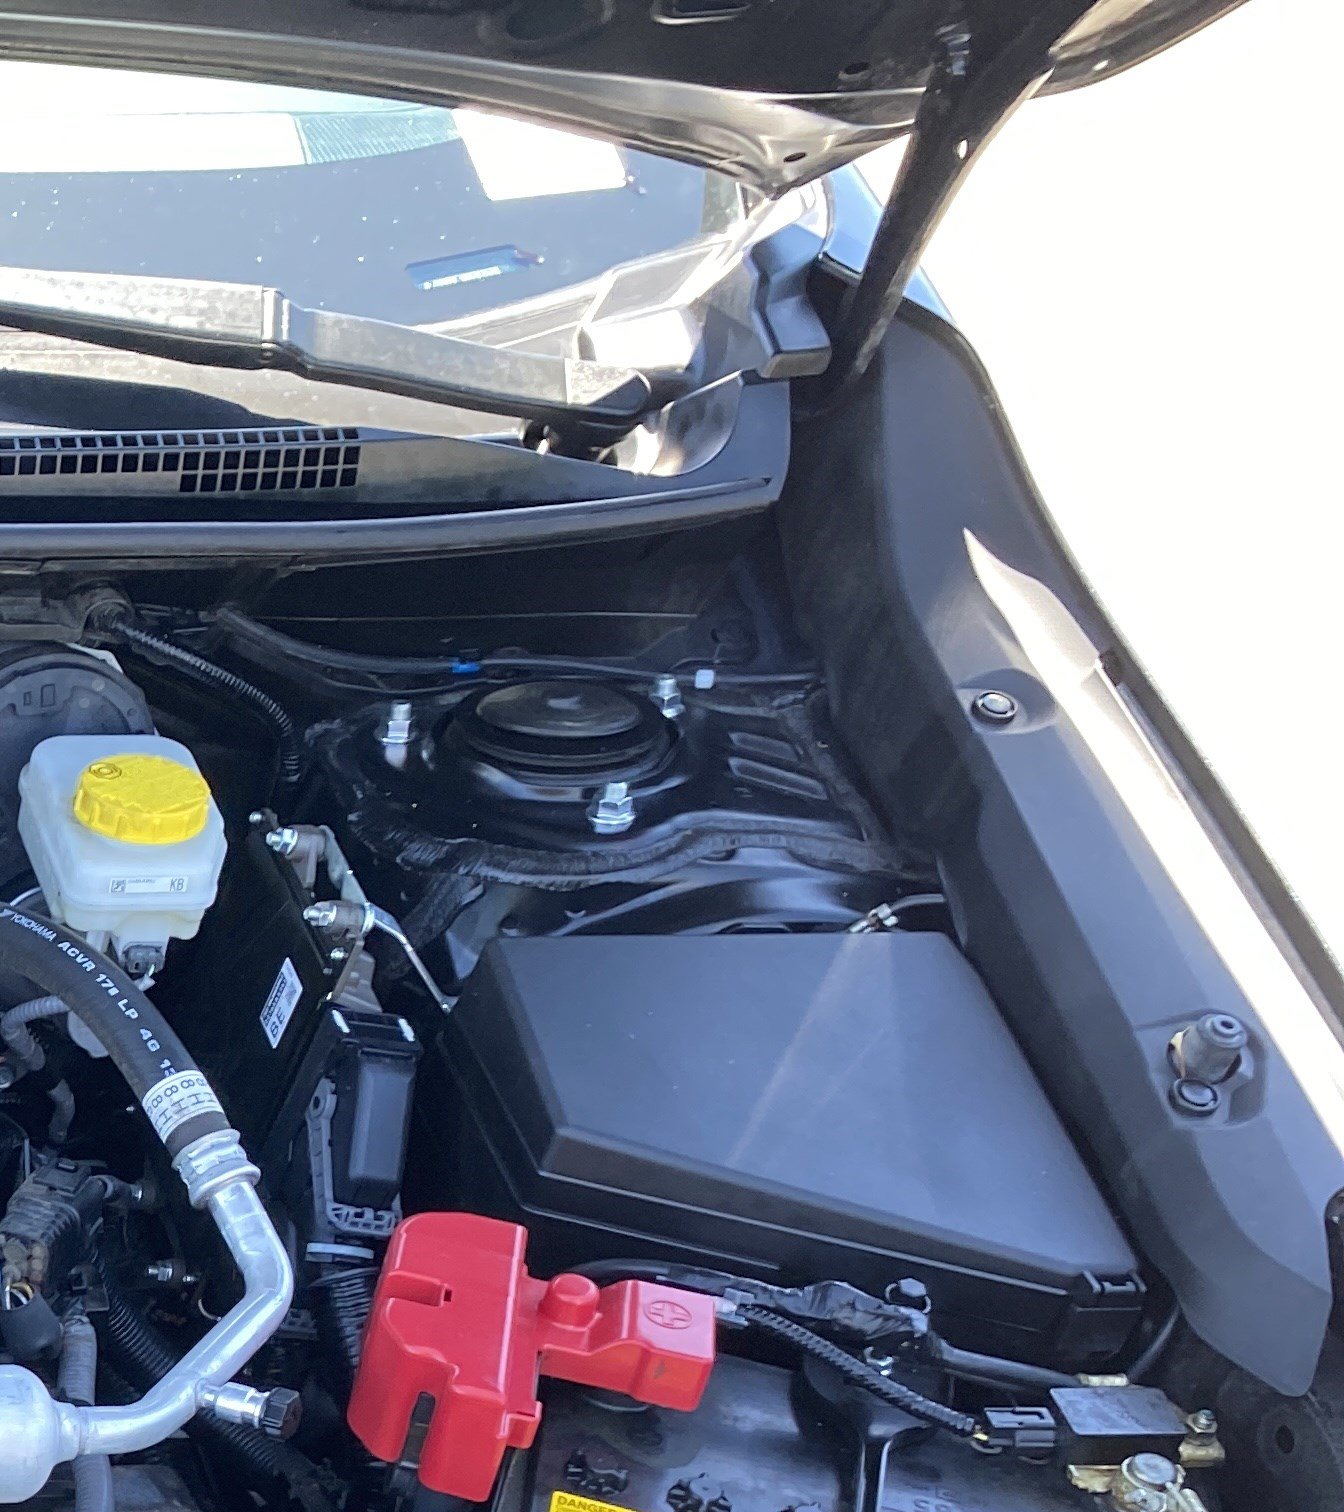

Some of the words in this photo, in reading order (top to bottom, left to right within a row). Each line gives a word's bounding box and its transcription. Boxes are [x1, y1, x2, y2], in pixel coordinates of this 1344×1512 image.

[169, 878, 185, 892] KB
[10, 913, 57, 942] YOKOHAMA
[57, 941, 96, 972] ACVR
[117, 998, 139, 1020] LP
[139, 1028, 161, 1053] 4G
